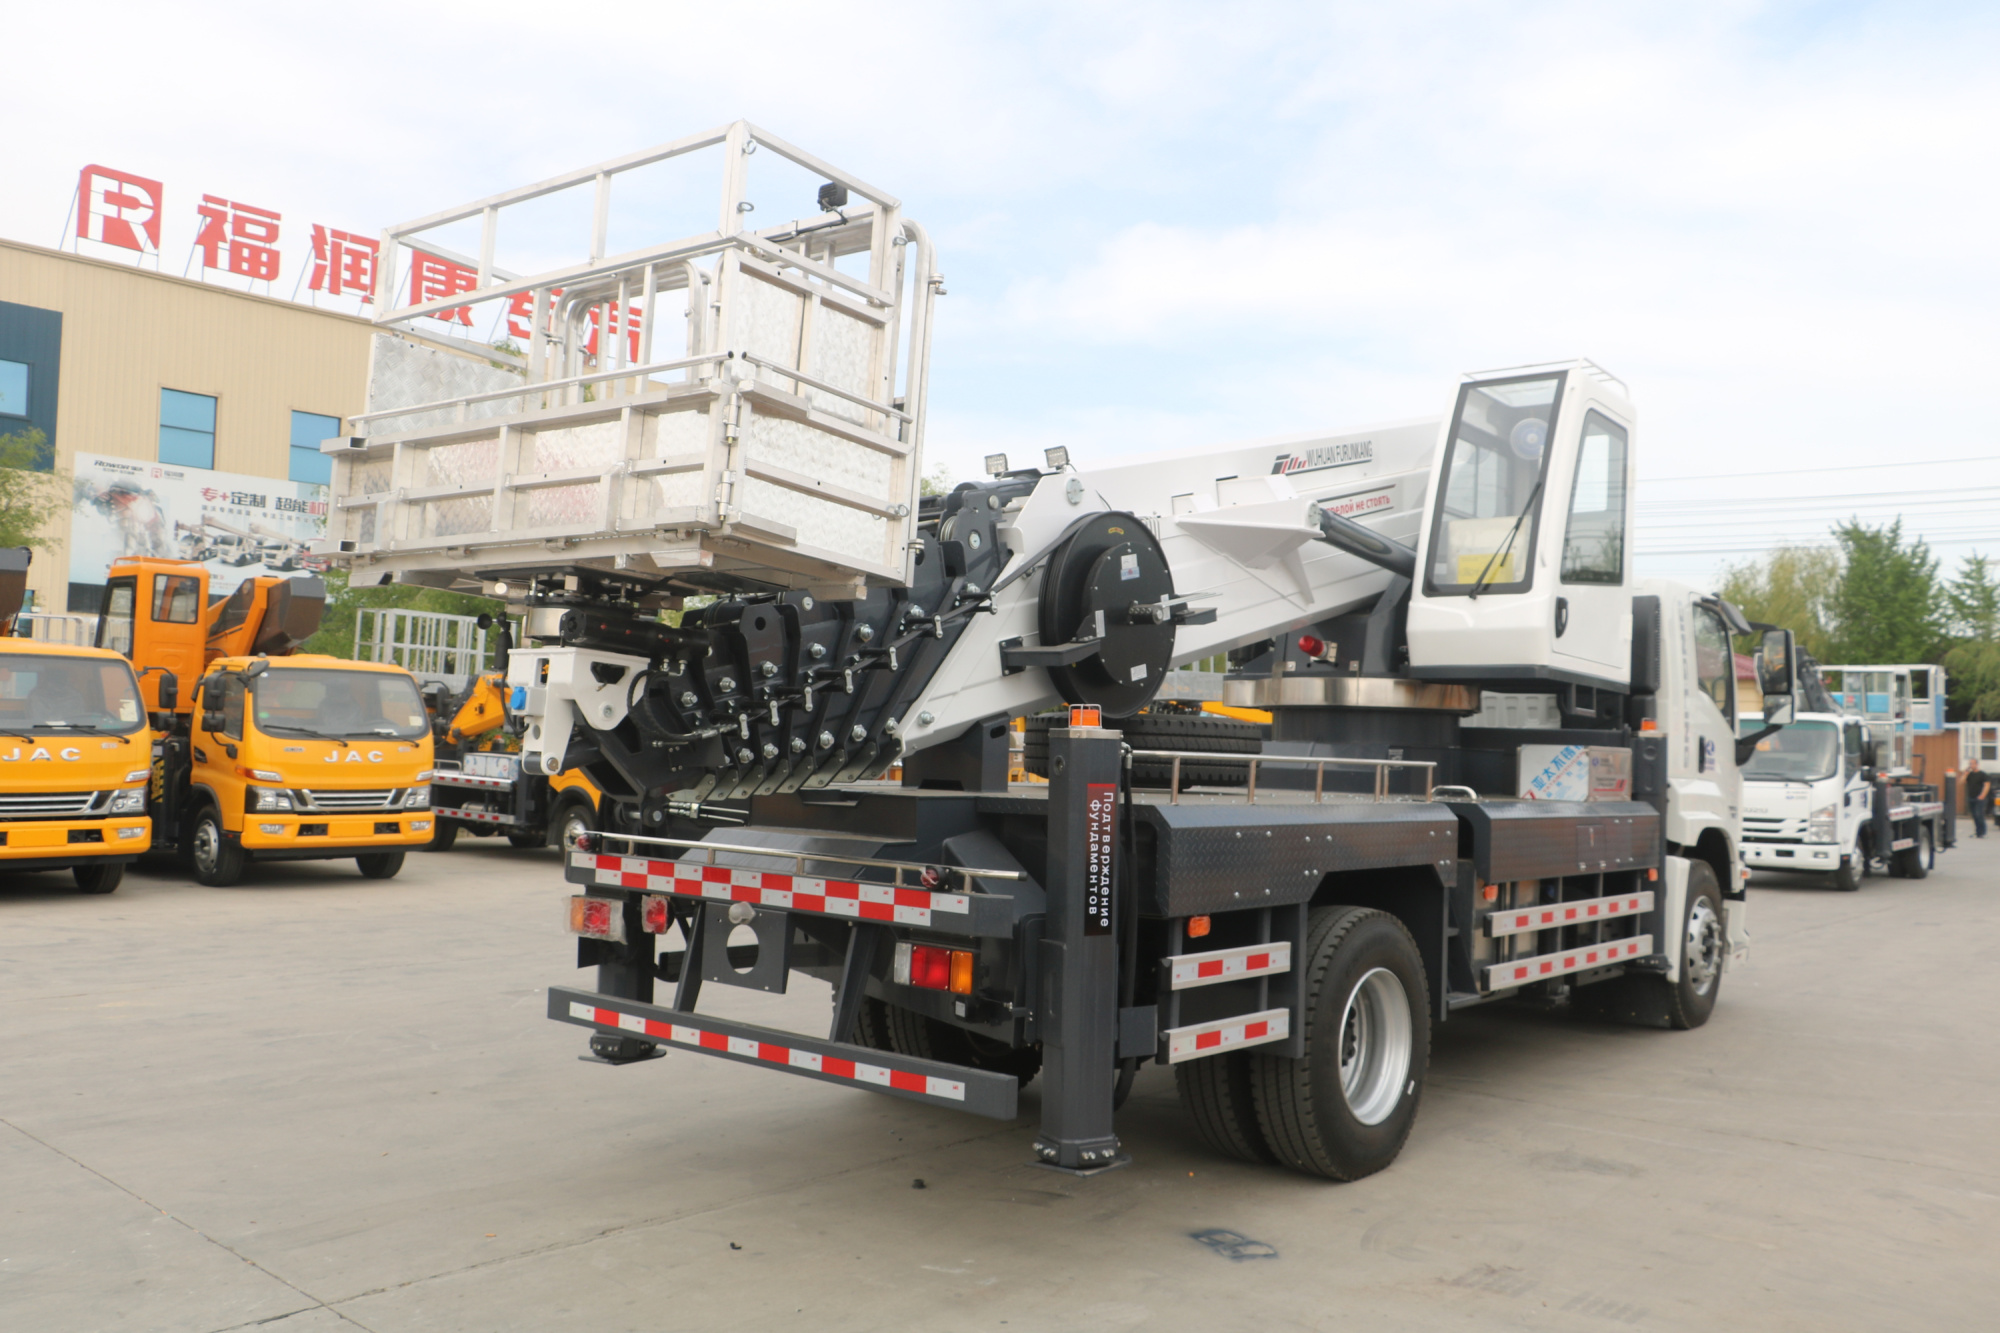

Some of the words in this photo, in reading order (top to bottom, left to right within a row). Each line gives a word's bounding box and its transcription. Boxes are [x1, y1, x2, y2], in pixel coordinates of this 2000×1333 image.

[1306, 446, 1335, 467] WUHUAN
[1356, 500, 1366, 511] не
[1366, 495, 1391, 509] стоять
[2, 747, 80, 761] JAC
[324, 750, 384, 763] JAC
[1089, 799, 1102, 915] фундаментов
[1100, 792, 1114, 927] Подтверждение
